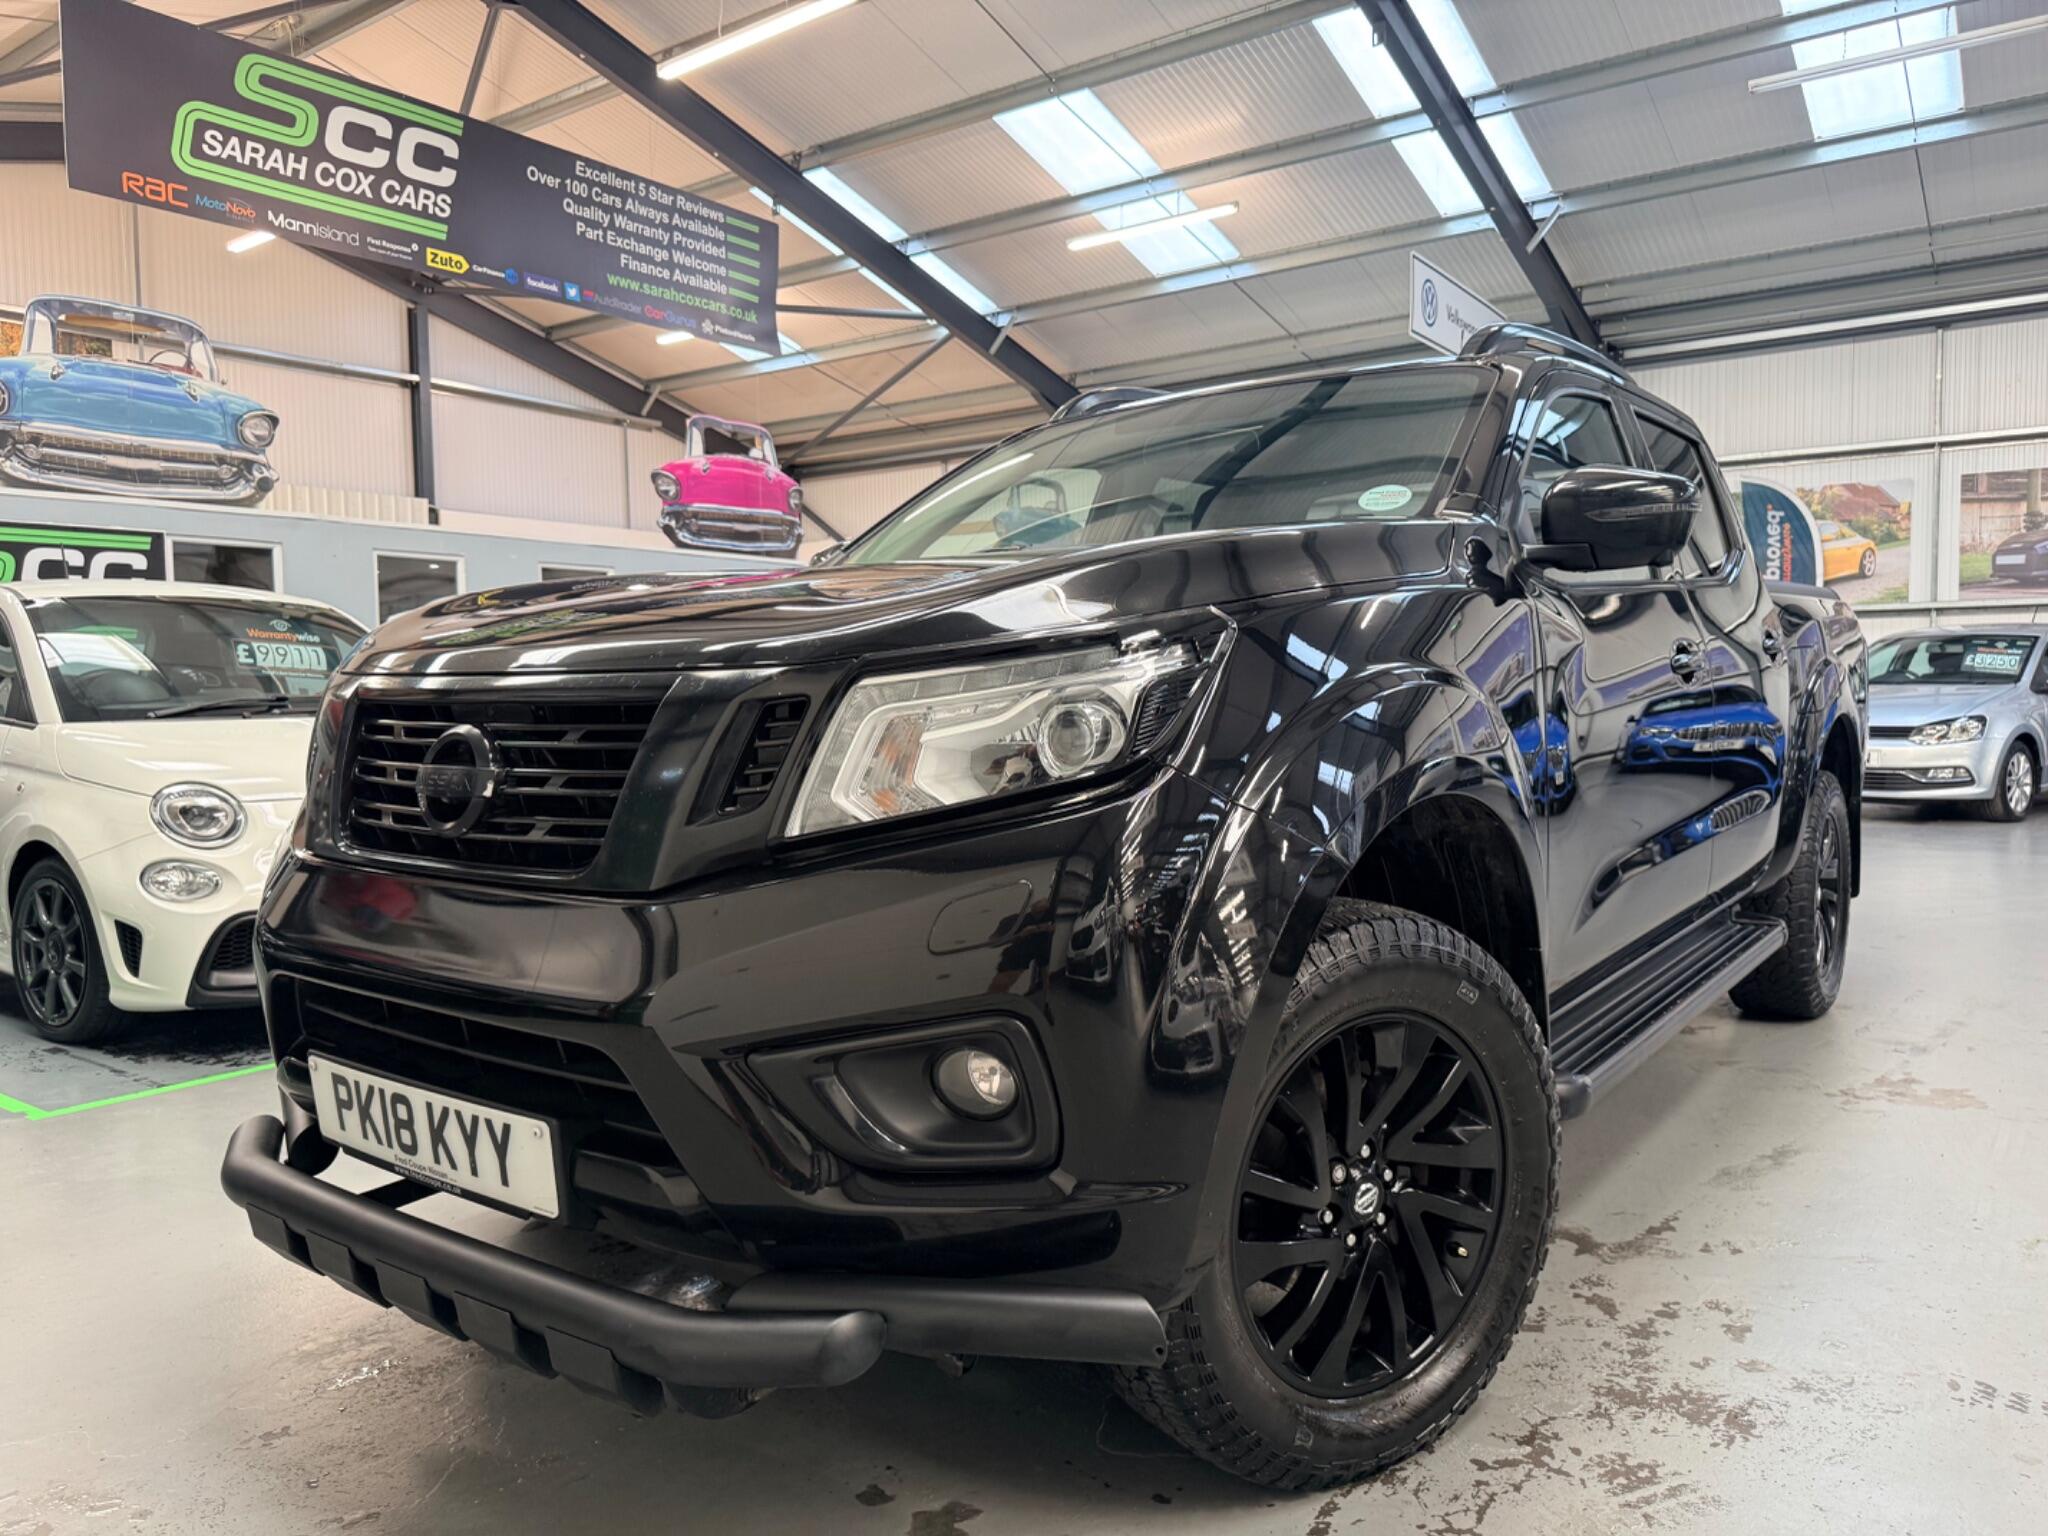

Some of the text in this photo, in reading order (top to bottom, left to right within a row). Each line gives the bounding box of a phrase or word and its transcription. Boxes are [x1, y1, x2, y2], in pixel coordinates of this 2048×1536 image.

[201, 129, 453, 218] SARAH COX CARS
[575, 160, 725, 223] Excellent 5 Star Reviews
[195, 194, 256, 219] MotoNovo
[527, 165, 725, 241] Over 100 Cars Always Available
[563, 197, 726, 259] Quality Warranty Provided
[430, 251, 463, 271] Zuto
[576, 220, 727, 277] Part Exchange Welcome
[620, 253, 728, 296] Finance Available
[526, 276, 559, 293] facebook
[607, 273, 758, 324] www.sarahcoxcars.co.uk
[330, 1071, 512, 1188] PK18 KYY
